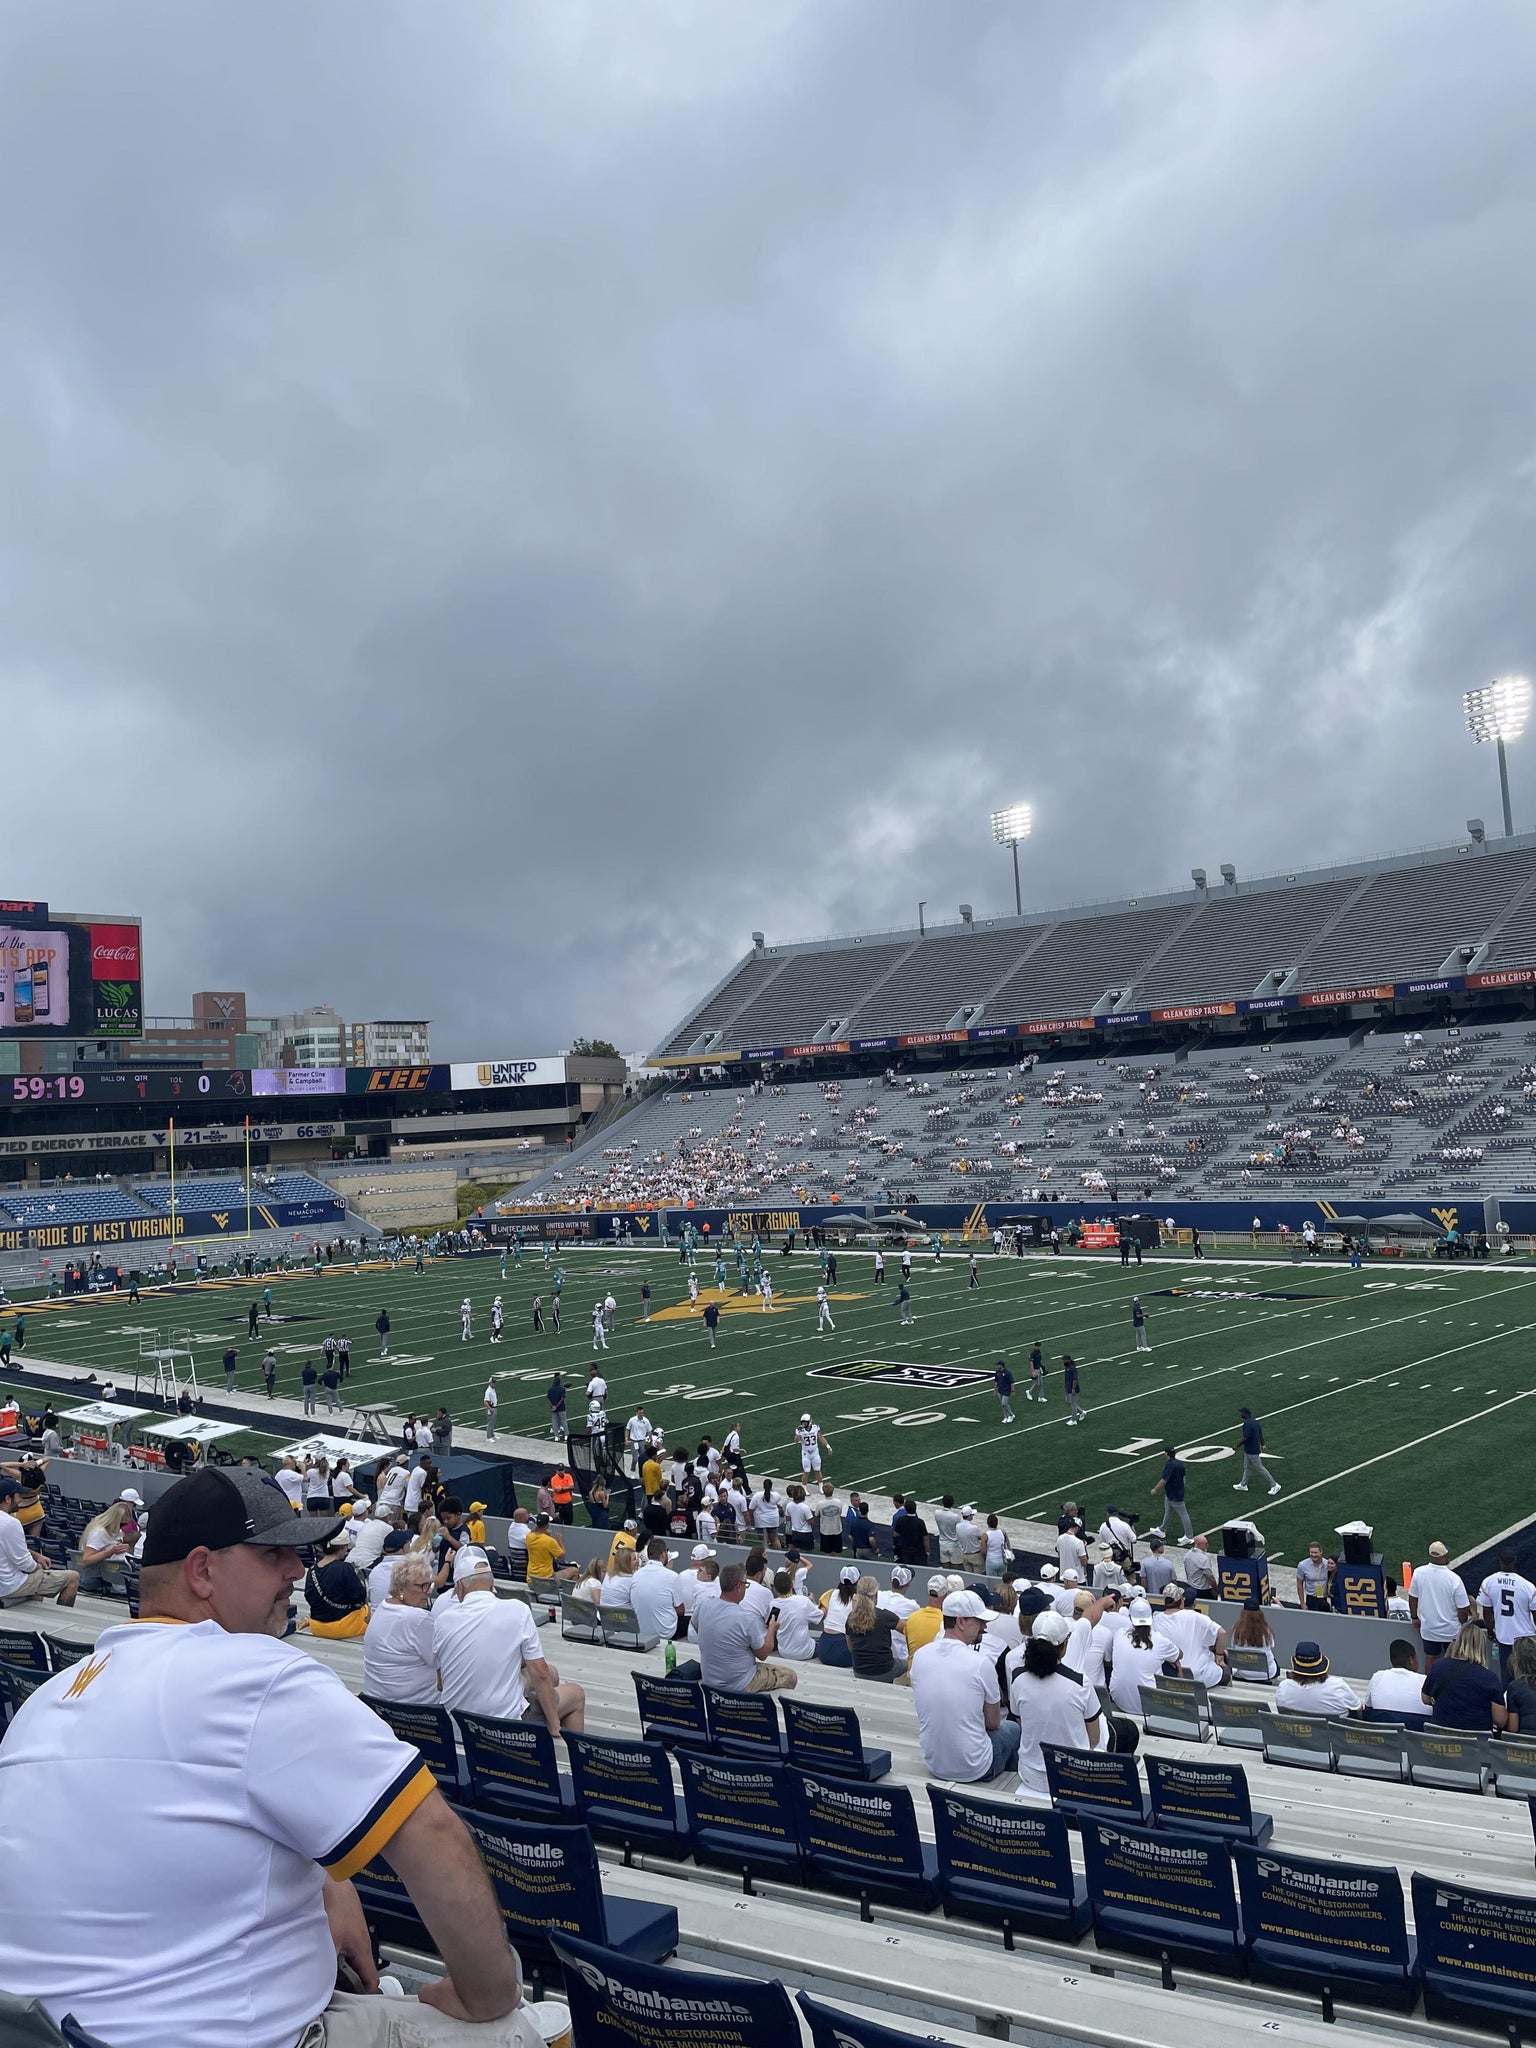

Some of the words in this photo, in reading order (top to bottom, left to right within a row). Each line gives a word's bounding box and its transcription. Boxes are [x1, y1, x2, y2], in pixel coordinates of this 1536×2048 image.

[26, 948, 56, 968] APP
[1481, 975, 1507, 985] CLEAN
[1508, 972, 1532, 982] CRISP
[1409, 984, 1426, 992] BUD
[1426, 982, 1448, 991] LIGHT
[1312, 993, 1334, 1003] CLEAN
[1335, 991, 1356, 1001] CRISP
[1358, 988, 1380, 998] TASTE
[1264, 1000, 1284, 1008] LIGHT
[97, 1008, 138, 1018] LUCAS
[1163, 1010, 1183, 1019] CLEAN
[1184, 1008, 1202, 1017] CRISP
[1203, 1006, 1223, 1015] TASTE
[991, 1028, 1006, 1036] LIGHT
[1029, 1024, 1047, 1032] CLEAN
[1048, 1022, 1065, 1030] CRISP
[1066, 1020, 1083, 1028] TASTE
[907, 1036, 924, 1044] CLEAN
[925, 1034, 940, 1042] CRISP
[940, 1032, 957, 1041] TASTE
[793, 1047, 808, 1055] CLEAN
[809, 1045, 824, 1053] CRISP
[825, 1044, 840, 1052] TASTE
[492, 1062, 537, 1074] UNITED
[198, 1075, 210, 1093] 0
[492, 1073, 525, 1084] BANK
[13, 1076, 85, 1100] 59:19
[137, 1082, 146, 1097] 1
[173, 1084, 180, 1095] 3
[184, 1131, 200, 1144] 21
[243, 1128, 260, 1140] 90
[297, 1126, 314, 1138] 66
[32, 1138, 85, 1151] ENERGY
[88, 1135, 147, 1148] TERRACE
[288, 1208, 324, 1216] NEMACOLIN
[334, 1200, 345, 1208] 40
[546, 1222, 564, 1230] UNITED
[29, 1227, 68, 1250] PRIDE
[73, 1225, 89, 1244] OF
[93, 1222, 126, 1242] WEST
[643, 1384, 734, 1400] 30
[835, 1406, 947, 1426] 20
[803, 1435, 817, 1447] 33
[1098, 1437, 1236, 1463] 10
[311, 1570, 323, 1597] FOOTBALL
[1497, 1578, 1516, 1587] WHITE
[1501, 1589, 1515, 1617] 5
[1274, 1721, 1312, 1733] RENTED
[1421, 1740, 1462, 1753] RENTED
[705, 1765, 773, 1782] Panhandle
[821, 1786, 892, 1810] Panhandle
[965, 1808, 1046, 1830] Panhandle
[967, 1818, 994, 1833] CLEANING
[475, 1828, 564, 1859] Panhandle
[1120, 1835, 1208, 1860] Panhandle
[1120, 1845, 1152, 1860] CLEANING
[1161, 1856, 1208, 1866] RESTORATION
[1104, 1858, 1135, 1872] COMPANY
[1136, 1869, 1145, 1877] OF
[1145, 1871, 1159, 1880] THE
[1113, 1853, 1124, 1862] THE
[1125, 1858, 1153, 1871] OFFICIAL
[1154, 1864, 1201, 1876] RESTORATION
[950, 1859, 1057, 1889] www.mountaineerseats.com
[1281, 1866, 1379, 1891] Panhandle
[1281, 1877, 1317, 1893] CLEANING
[1326, 1888, 1378, 1898] RESTORATION
[1103, 1889, 1221, 1920] www.mountaineerseats.com
[1262, 1891, 1296, 1908] COMPANY
[1297, 1903, 1308, 1911] OF
[1308, 1905, 1322, 1916] THE
[1272, 1885, 1285, 1894] THE
[1286, 1890, 1317, 1905] OFFICIAL
[1318, 1899, 1370, 1910] RESTORATION
[1463, 1905, 1504, 1918] CLEANING
[1451, 1913, 1468, 1922] THE
[1468, 1917, 1503, 1930] OFFICIAL
[1260, 1922, 1390, 1954] www.mountaineerseats.com
[1440, 1920, 1480, 1935] COMPANY
[1480, 1928, 1491, 1937] OF
[1493, 1930, 1508, 1941] THE
[607, 1977, 750, 2014] Panhandle
[611, 1997, 661, 2019] CLEANING
[664, 2012, 673, 2021] &
[674, 2012, 753, 2023] RESTORATION
[1262, 2021, 1280, 2030] 27
[665, 2029, 743, 2042] RESTORATION
